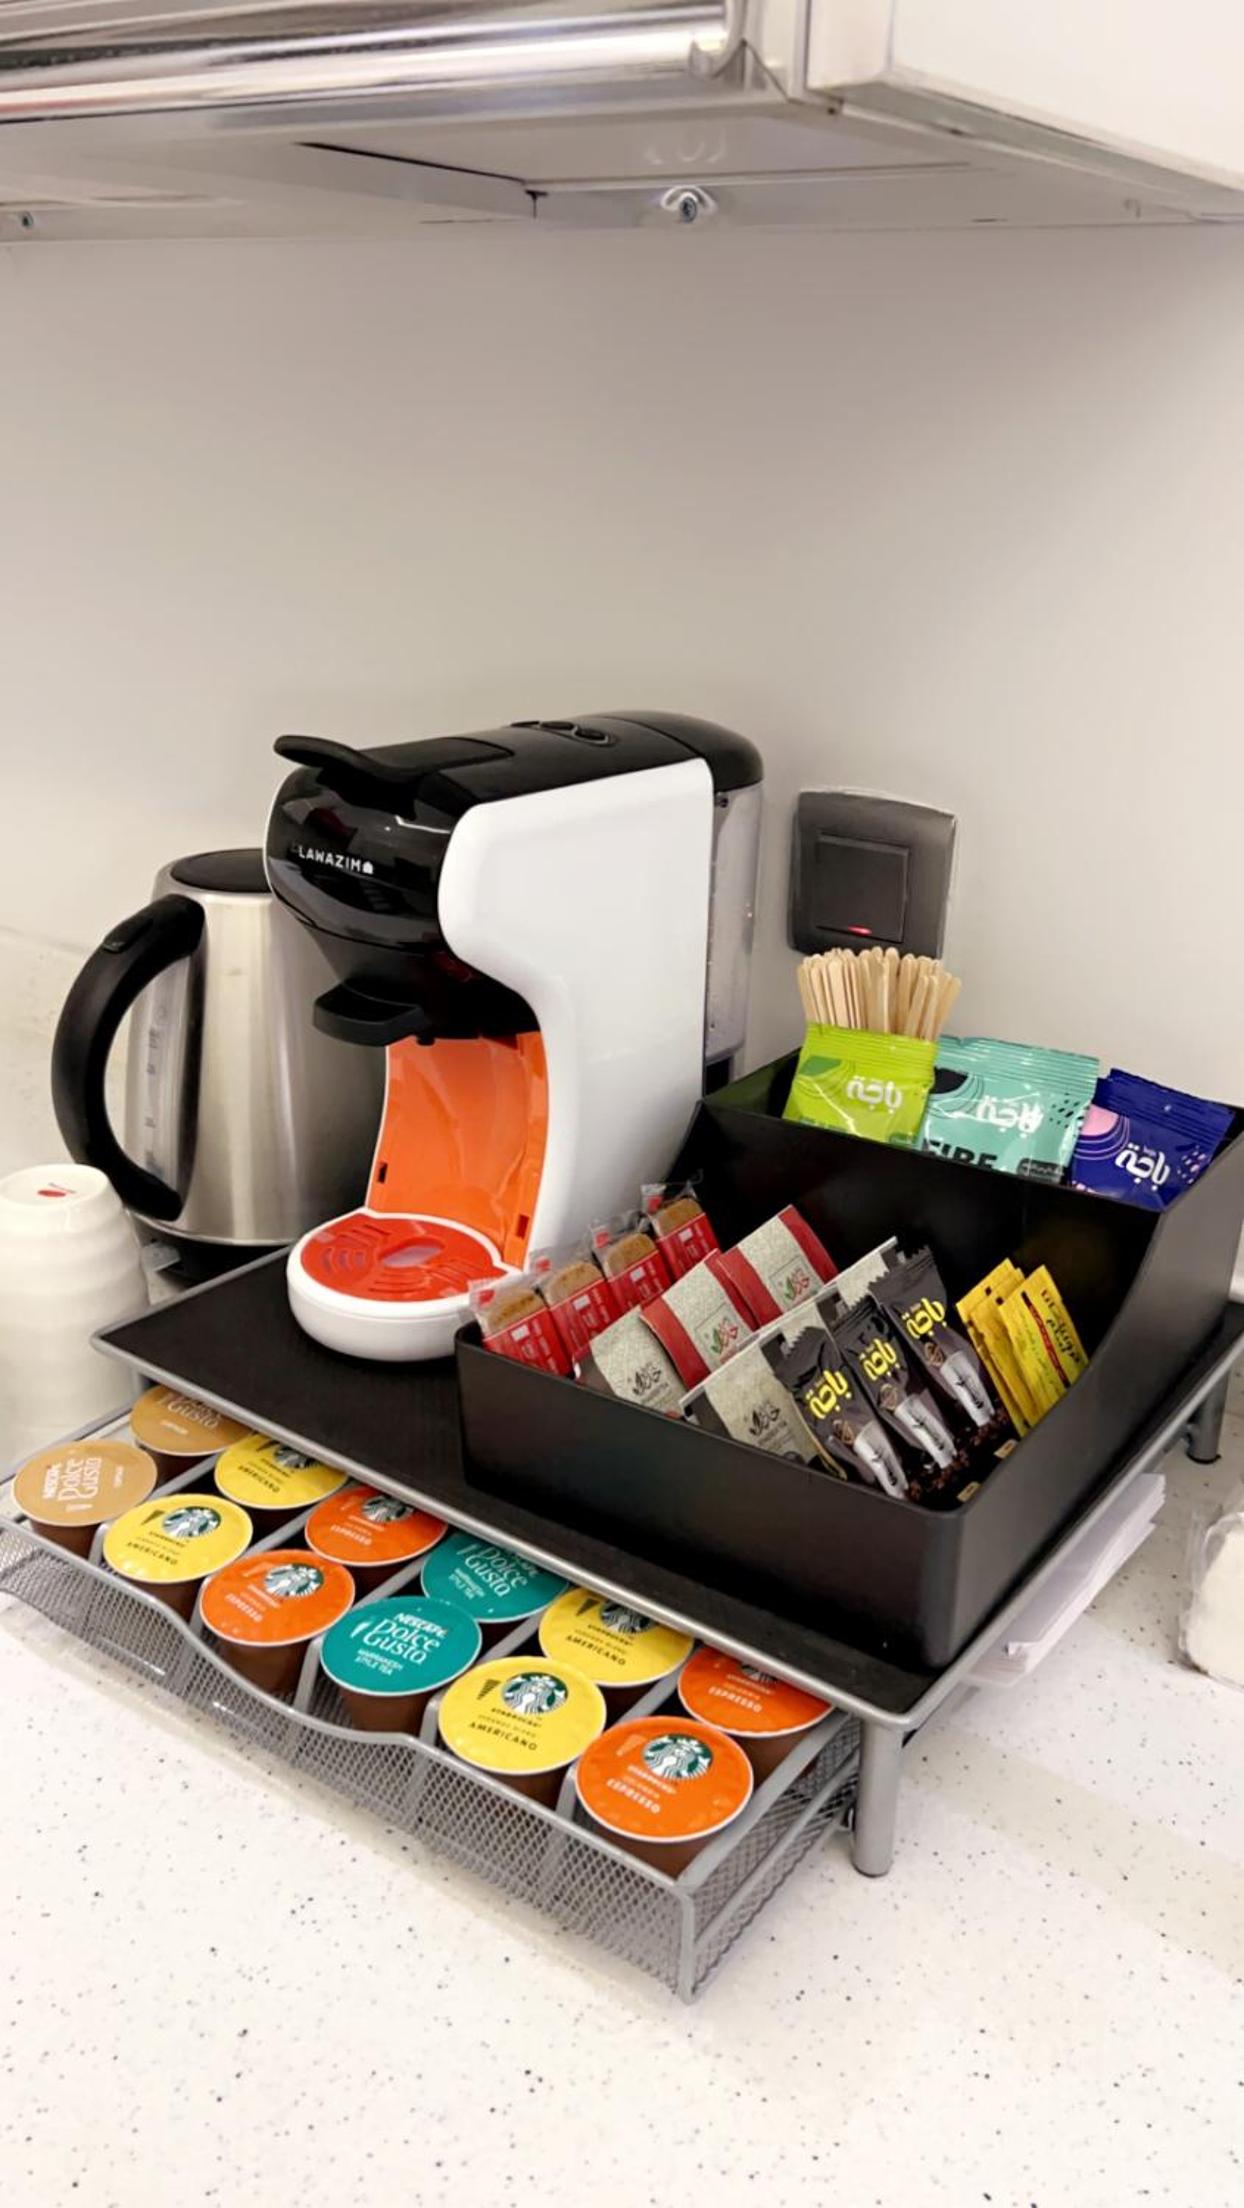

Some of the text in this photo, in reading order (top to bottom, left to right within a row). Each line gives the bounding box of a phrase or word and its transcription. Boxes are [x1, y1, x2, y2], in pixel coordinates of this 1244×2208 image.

[298, 845, 361, 873] LAWAZIM
[1115, 1142, 1171, 1191] باجة
[363, 1631, 427, 1665] Gusto
[372, 1618, 440, 1652] Dolce
[566, 1634, 626, 1666] AMERICANO
[708, 1686, 762, 1713] ESPRESSO
[469, 1721, 538, 1751] AMERICANO
[606, 1778, 660, 1814] ESPRESSO
